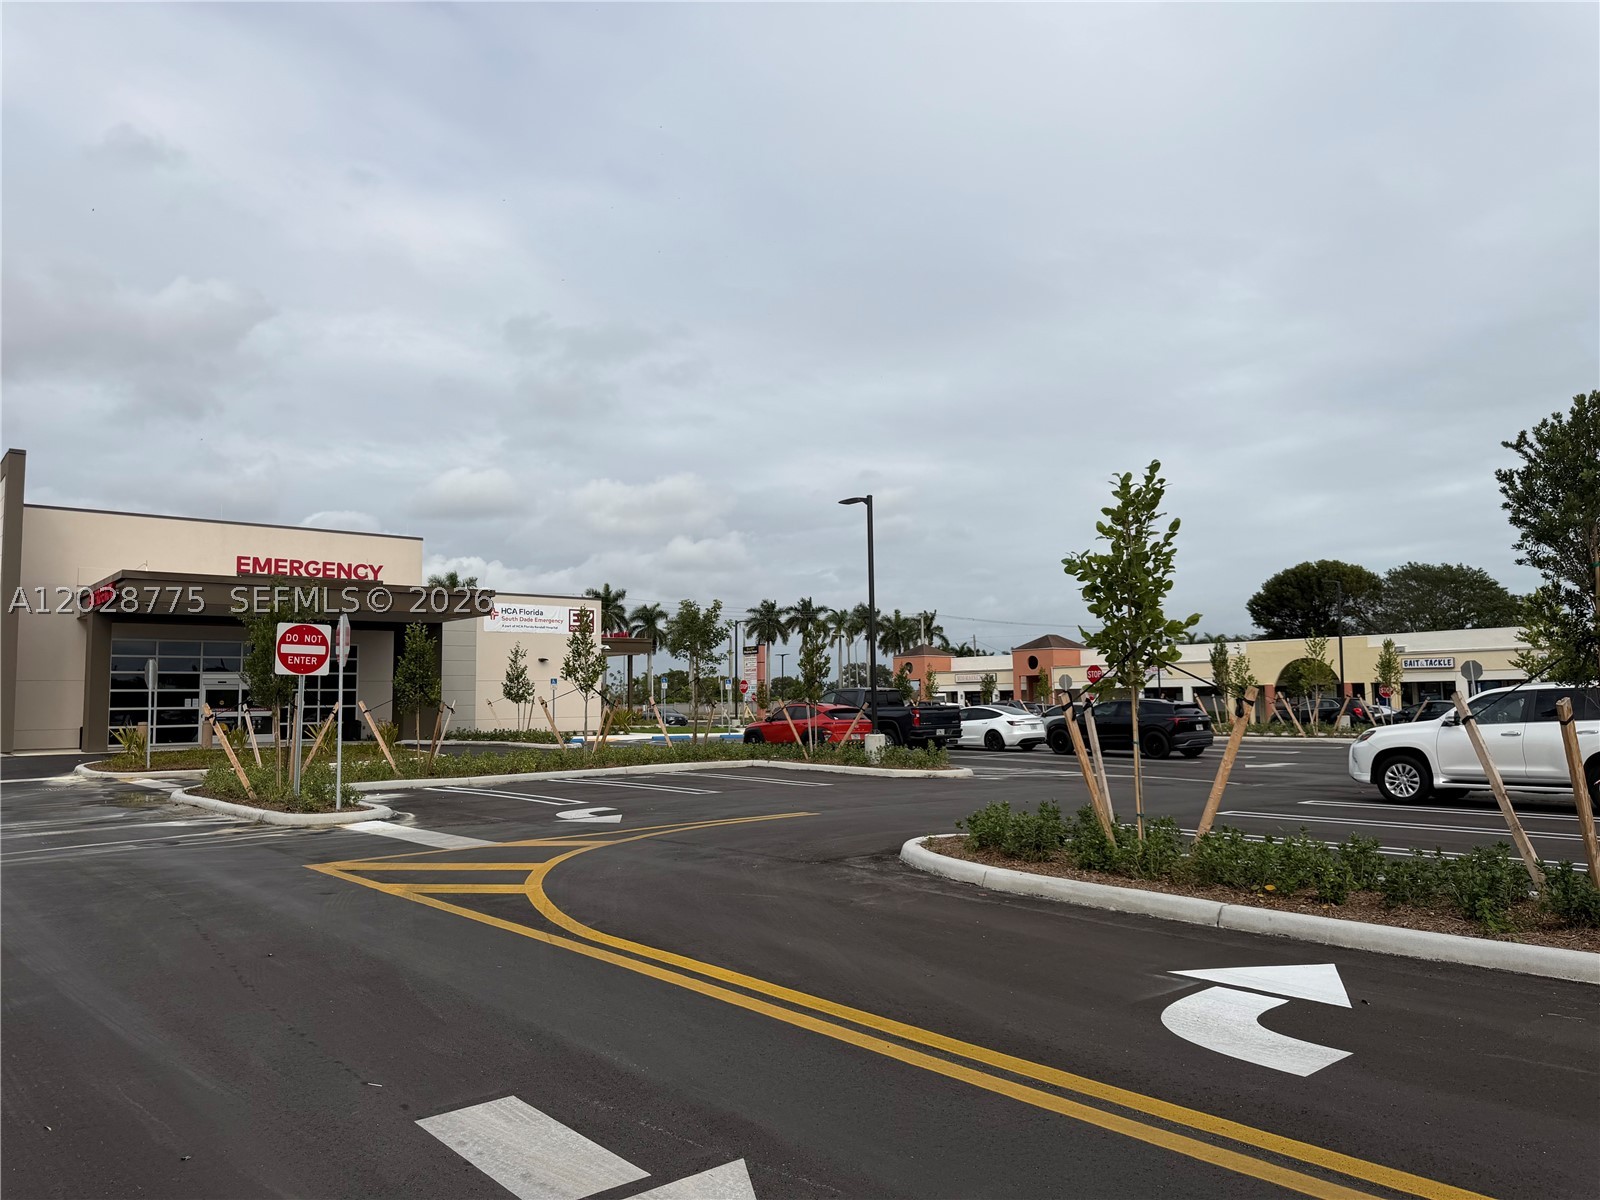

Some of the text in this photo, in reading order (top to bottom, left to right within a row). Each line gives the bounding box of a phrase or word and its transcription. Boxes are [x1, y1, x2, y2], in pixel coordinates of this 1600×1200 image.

[236, 556, 384, 581] EMERGENCY
[501, 607, 544, 616] HCA Florida
[285, 633, 323, 643] DO NOT
[287, 655, 318, 665] ENTER
[1403, 659, 1419, 667] BAIT
[1425, 658, 1452, 667] TACKLE
[1087, 670, 1102, 679] STOP
[1380, 685, 1393, 694] STOP
